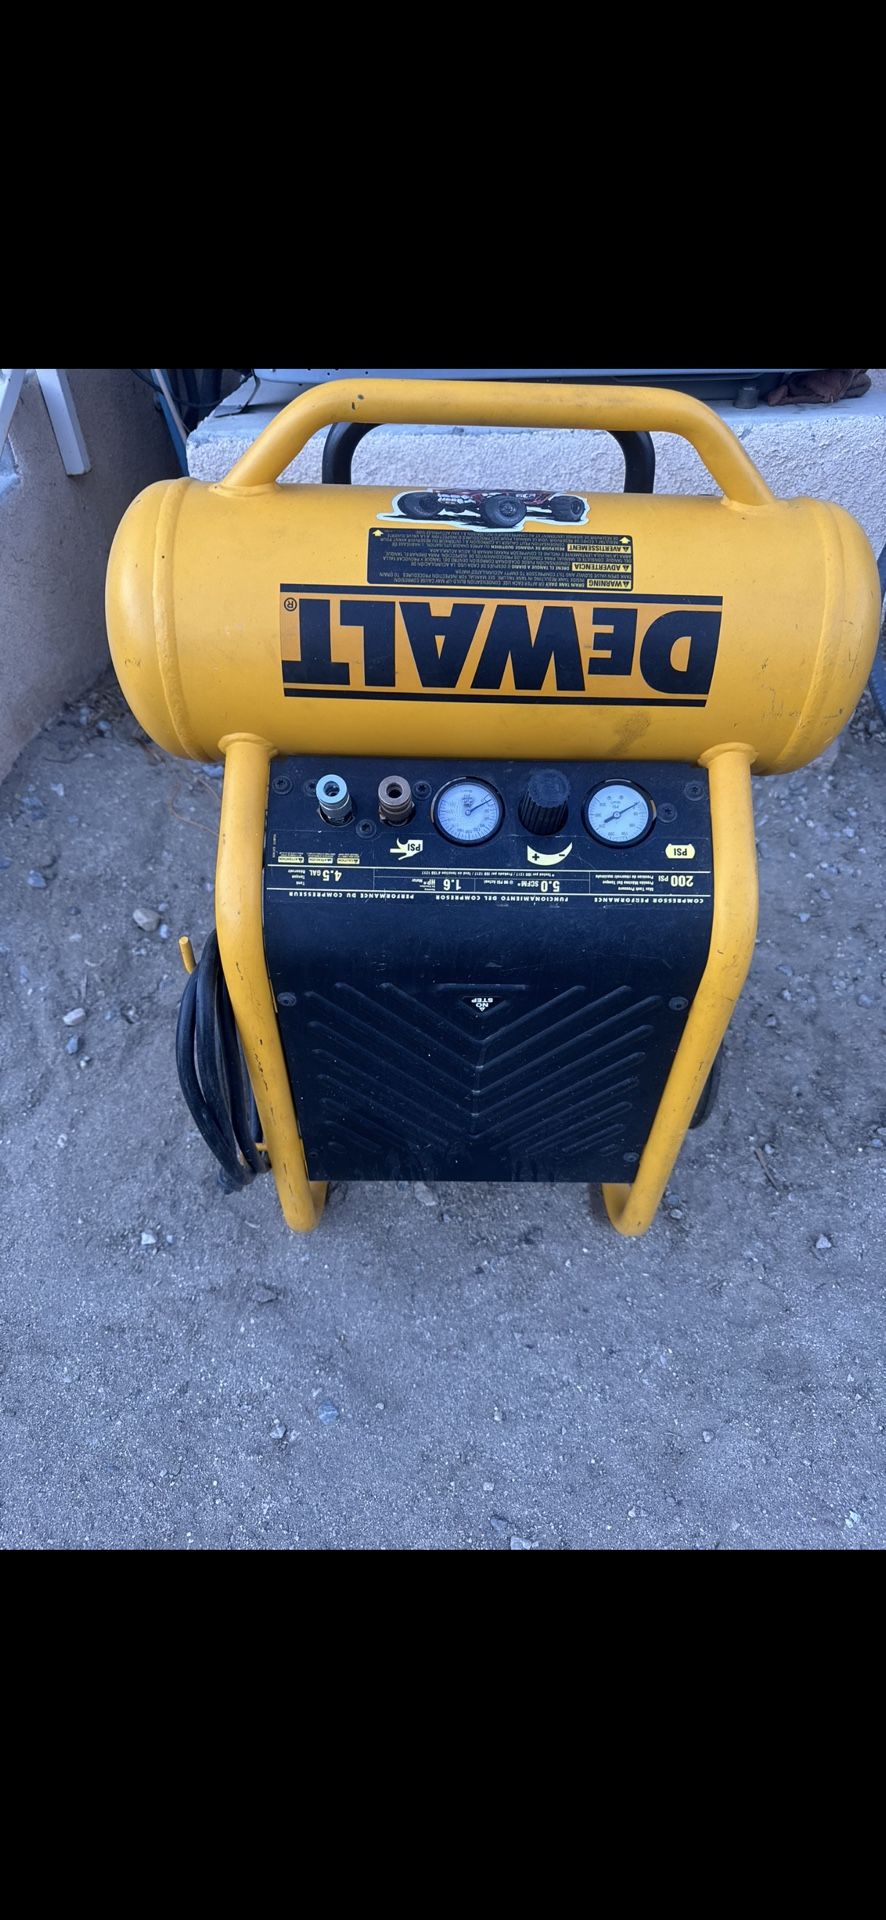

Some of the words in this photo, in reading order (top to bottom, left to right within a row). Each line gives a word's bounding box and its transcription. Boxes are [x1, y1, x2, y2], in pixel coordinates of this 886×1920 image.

[323, 870, 342, 881] 4.5
[671, 875, 694, 887] 200
[443, 879, 461, 890] 1.6
[541, 881, 560, 892] 5.0
